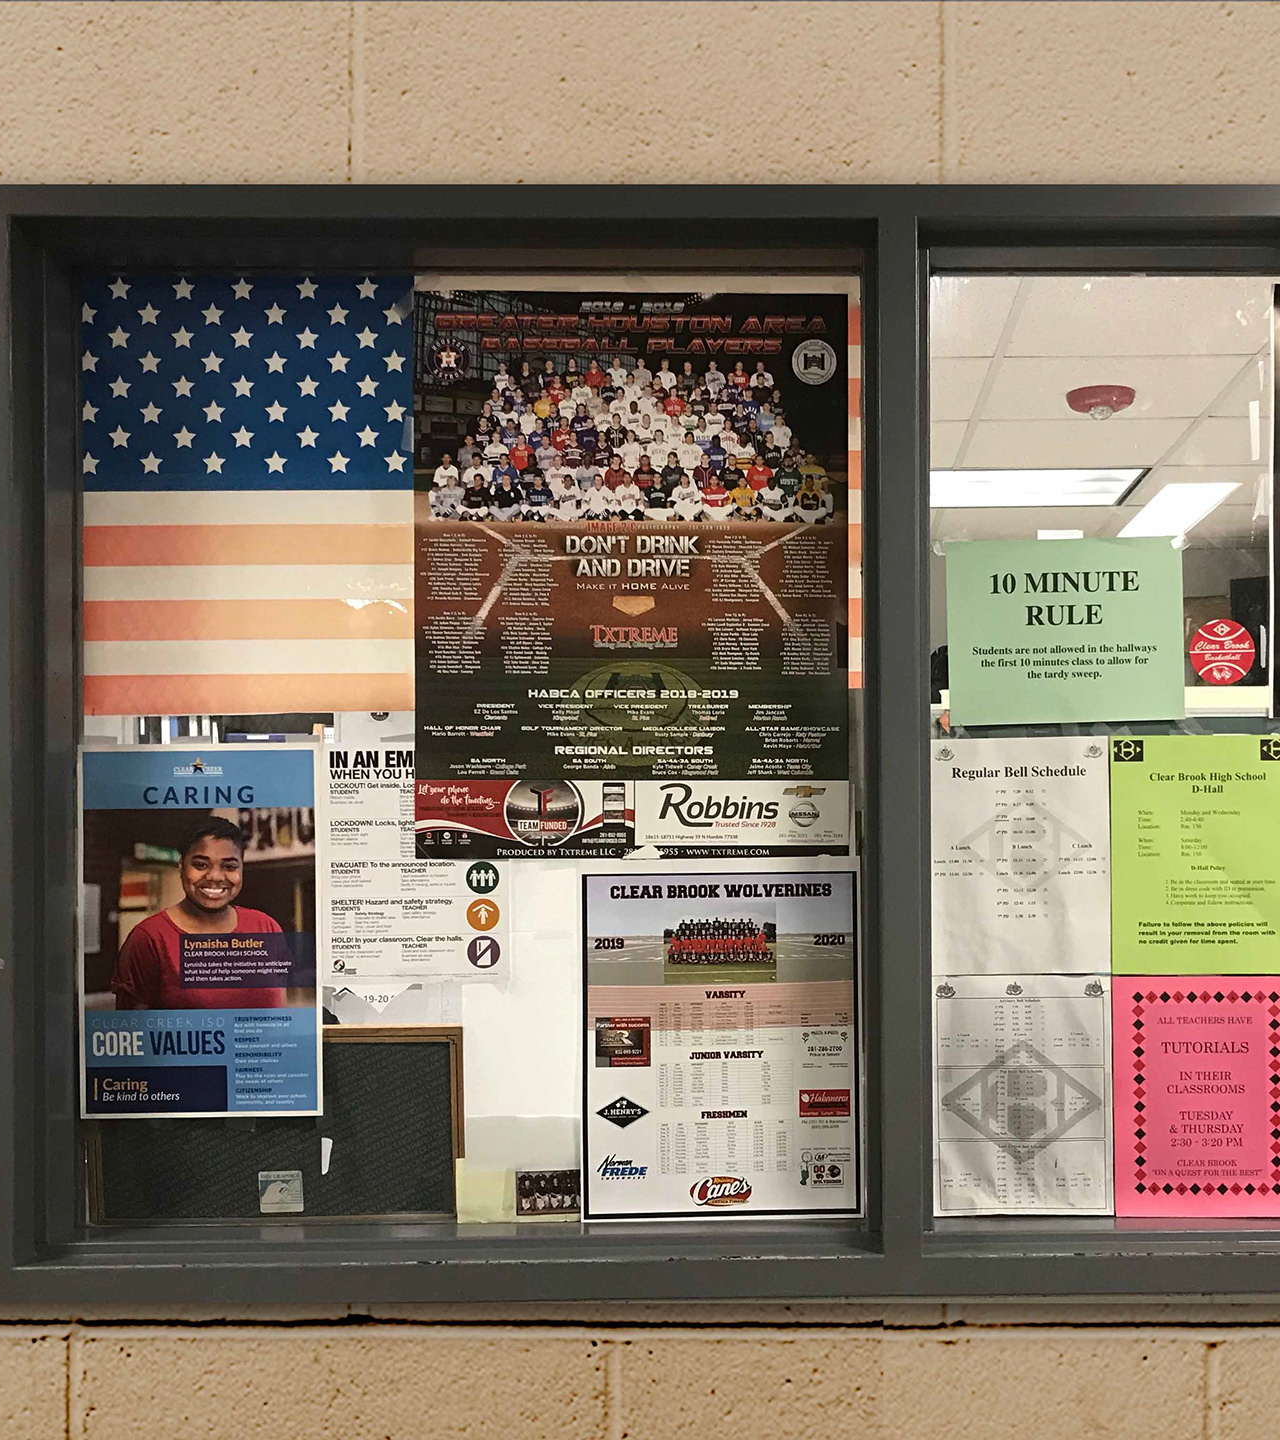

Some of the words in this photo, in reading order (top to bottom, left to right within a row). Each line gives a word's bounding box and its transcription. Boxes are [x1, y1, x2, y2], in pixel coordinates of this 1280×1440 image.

[435, 314, 580, 332] GREATER
[587, 314, 732, 333] HOUSTON
[739, 315, 827, 333] AREA
[481, 337, 638, 353] BASEBALL
[646, 337, 783, 354] PLAYERS
[566, 536, 629, 554] DON'T
[637, 536, 699, 554] DRINK
[576, 559, 620, 577] AND
[628, 559, 690, 577] DRIVE
[990, 573, 1016, 594] 10
[1024, 571, 1139, 593] MINUTE
[1025, 604, 1103, 626] RULE
[590, 625, 678, 643] TXTREME
[972, 646, 1012, 655] Students
[1033, 646, 1047, 654] not
[1050, 645, 1086, 654] allowed
[1087, 644, 1097, 653] in
[1099, 644, 1114, 653] the
[1116, 643, 1157, 654] hallways
[1195, 641, 1220, 651] Clear
[1223, 640, 1250, 649] Brook
[1028, 670, 1042, 679] the
[1044, 670, 1069, 681] tardy
[1072, 671, 1102, 681] sweep.
[528, 690, 580, 698] HABCA
[585, 690, 654, 698] OFFICERS
[660, 690, 738, 698] 2018-2019
[555, 746, 628, 755] REGIONAL
[633, 746, 713, 755] DIRECTORS
[330, 751, 348, 768] IN
[354, 751, 379, 768] AN
[330, 769, 368, 779] WHEN
[372, 769, 397, 779] YOU
[952, 767, 1000, 781] Regular
[1004, 766, 1028, 777] Bell
[1032, 766, 1086, 777] Schedule
[1150, 773, 1175, 781] Clear
[1178, 773, 1206, 781] Brook
[1210, 772, 1232, 782] High
[1235, 772, 1266, 781] School
[1192, 785, 1223, 793] D-Hall
[143, 786, 255, 805] CARING
[659, 783, 780, 827] Robbins
[518, 821, 539, 830] TEAM
[540, 821, 567, 830] FUNDED
[610, 885, 663, 899] CLEAR
[667, 884, 720, 898] BROOK
[724, 882, 832, 898] WOLVERINES
[184, 939, 228, 950] Lynaisha
[232, 938, 264, 948] Butler
[594, 938, 625, 950] 2019
[813, 934, 845, 945] 2020
[705, 990, 746, 999] VARSITY
[92, 1031, 144, 1056] CORE
[150, 1030, 226, 1055] VALUES
[1161, 1041, 1250, 1054] TUTORIALS
[103, 1078, 148, 1093] Caring
[1167, 1084, 1245, 1094] CLASSROOMS
[103, 1092, 114, 1101] Be
[117, 1092, 137, 1101] kind
[139, 1092, 148, 1101] to
[151, 1091, 180, 1100] others
[701, 1110, 747, 1119] FRESHMEN
[1179, 1111, 1233, 1121] TUESDAY
[693, 1179, 751, 1206] Cane's
